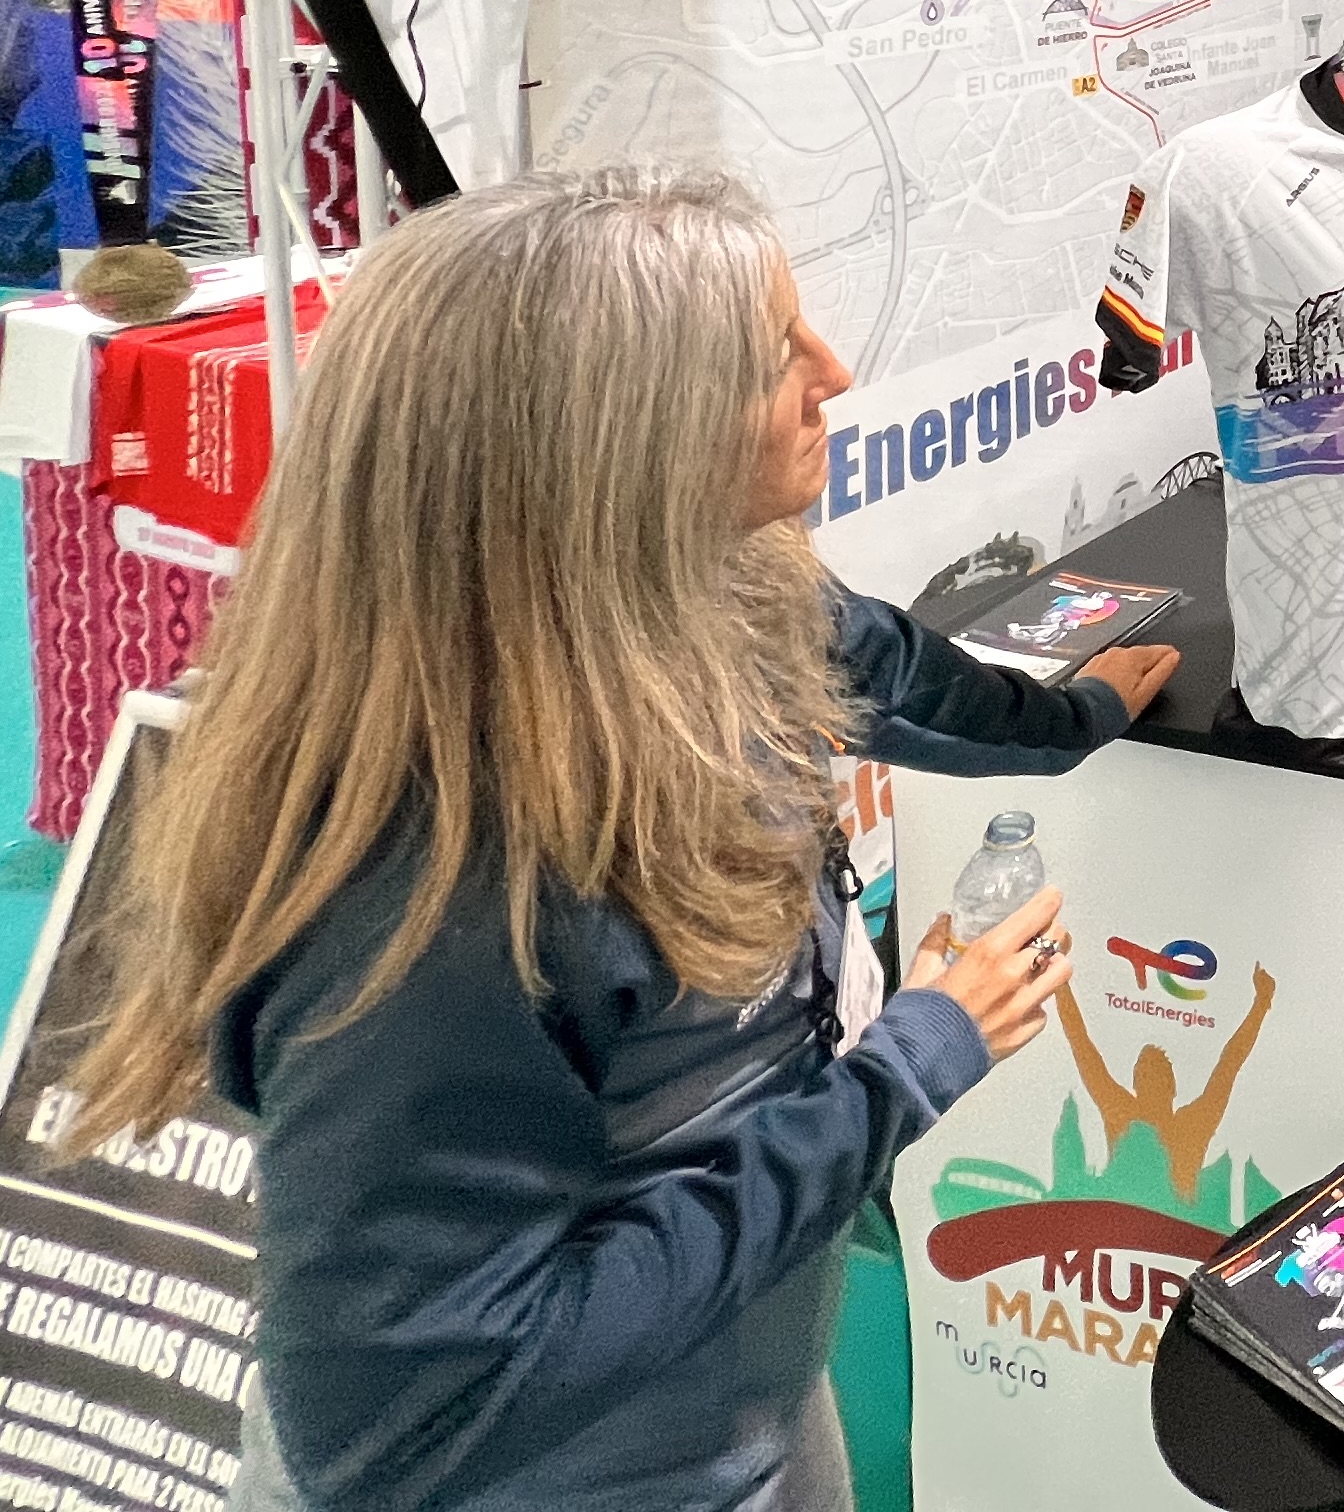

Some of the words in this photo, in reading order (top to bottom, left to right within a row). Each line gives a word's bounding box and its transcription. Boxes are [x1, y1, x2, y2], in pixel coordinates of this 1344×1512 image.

[849, 35, 893, 59] San
[902, 25, 967, 53] Pedro
[1037, 35, 1051, 47] DE
[1045, 19, 1082, 31] PUENTE
[966, 75, 989, 96] El
[993, 64, 1068, 91] Carmen
[828, 349, 1098, 524] Energies
[1105, 991, 1216, 1029] TotalEnergies
[7, 1234, 132, 1299] COMPARTES
[127, 1268, 156, 1306] EL
[152, 1275, 247, 1336] HASHTAG
[1043, 1248, 1190, 1314] MUR
[6, 1286, 187, 1380] REGALAMOS
[179, 1336, 243, 1402] UNA
[985, 1280, 1165, 1369] MARA
[108, 1458, 160, 1503] PARA
[154, 1474, 175, 1509] 2
